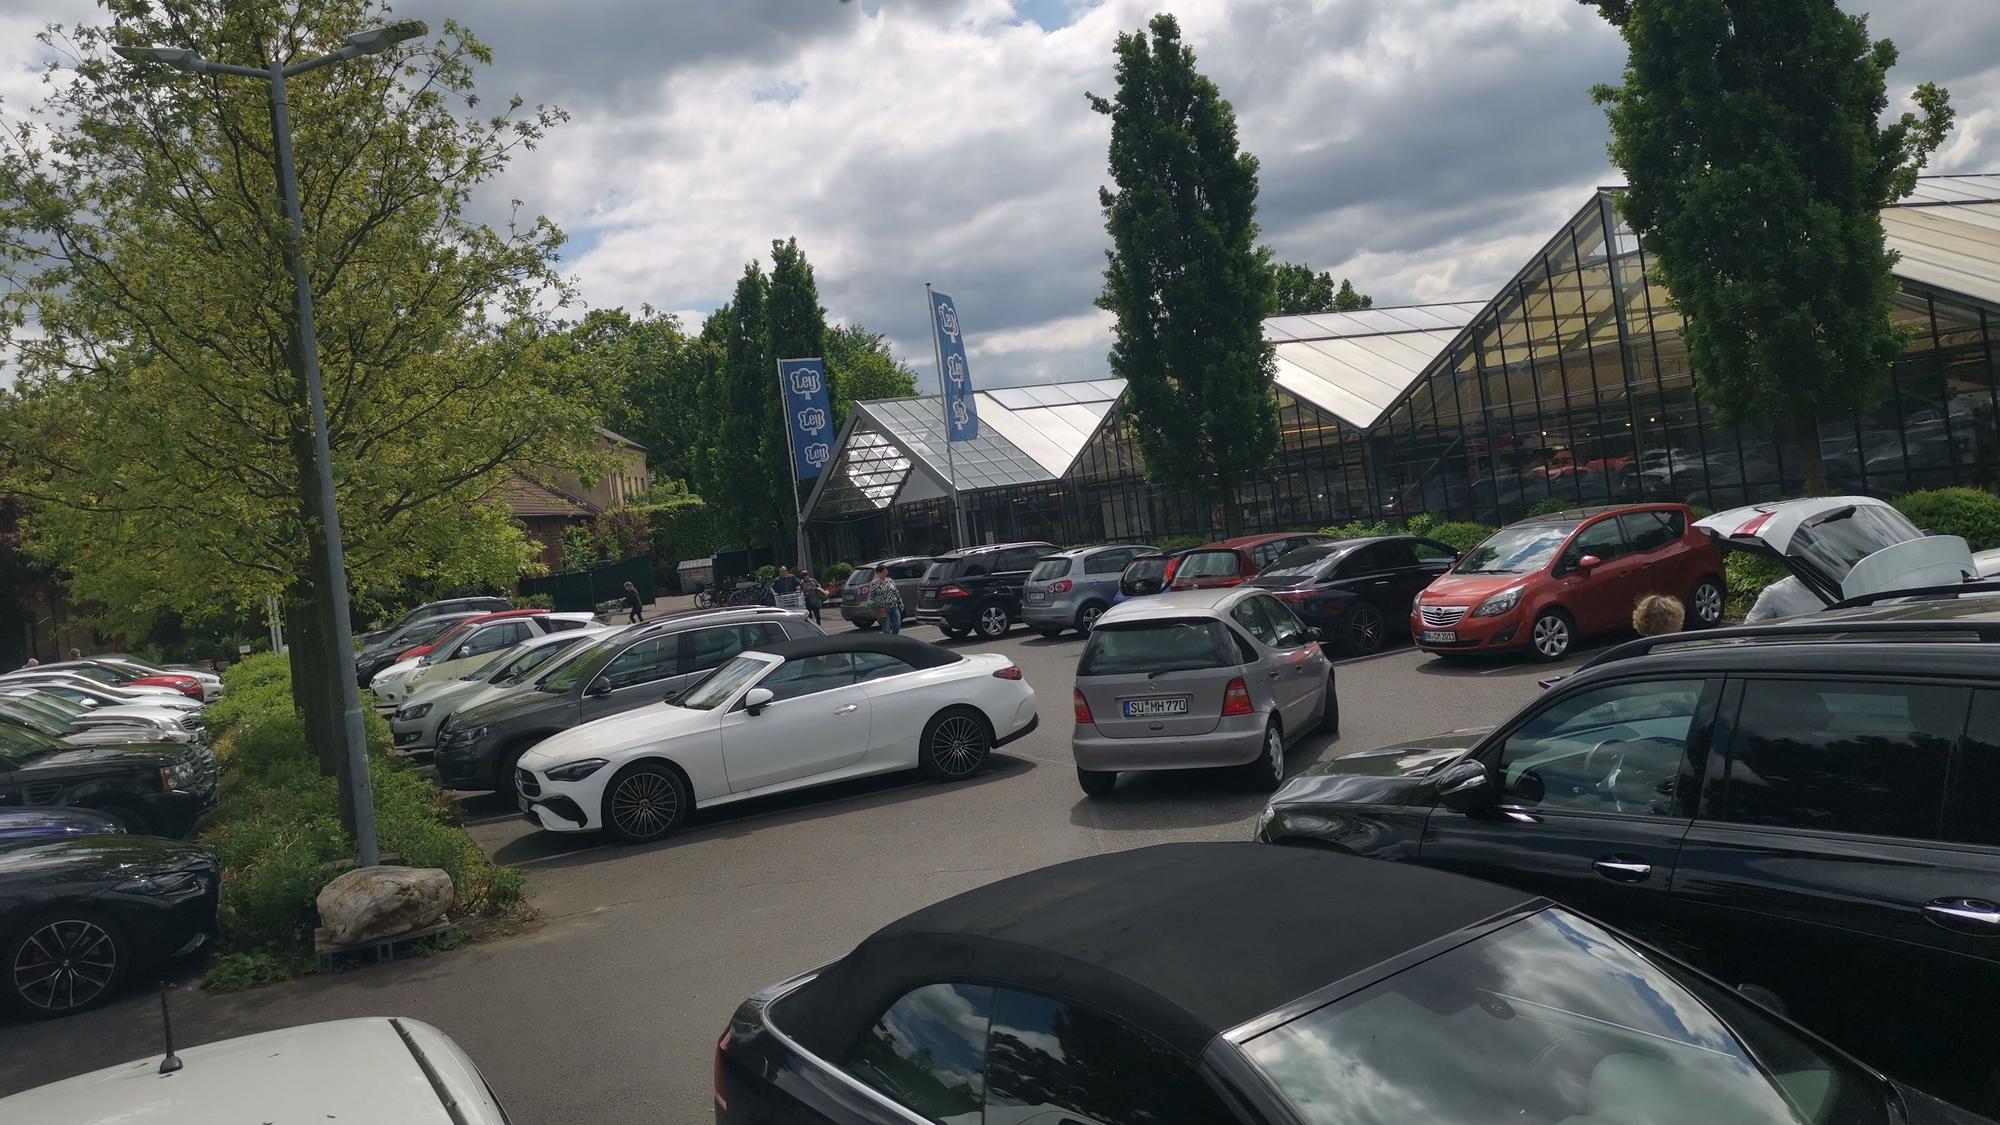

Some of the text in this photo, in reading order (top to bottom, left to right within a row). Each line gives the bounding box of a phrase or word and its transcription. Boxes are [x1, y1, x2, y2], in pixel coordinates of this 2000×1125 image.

[795, 375, 817, 390] Ley
[802, 413, 822, 427] Ley
[808, 447, 826, 460] Ley
[1131, 701, 1144, 713] SU
